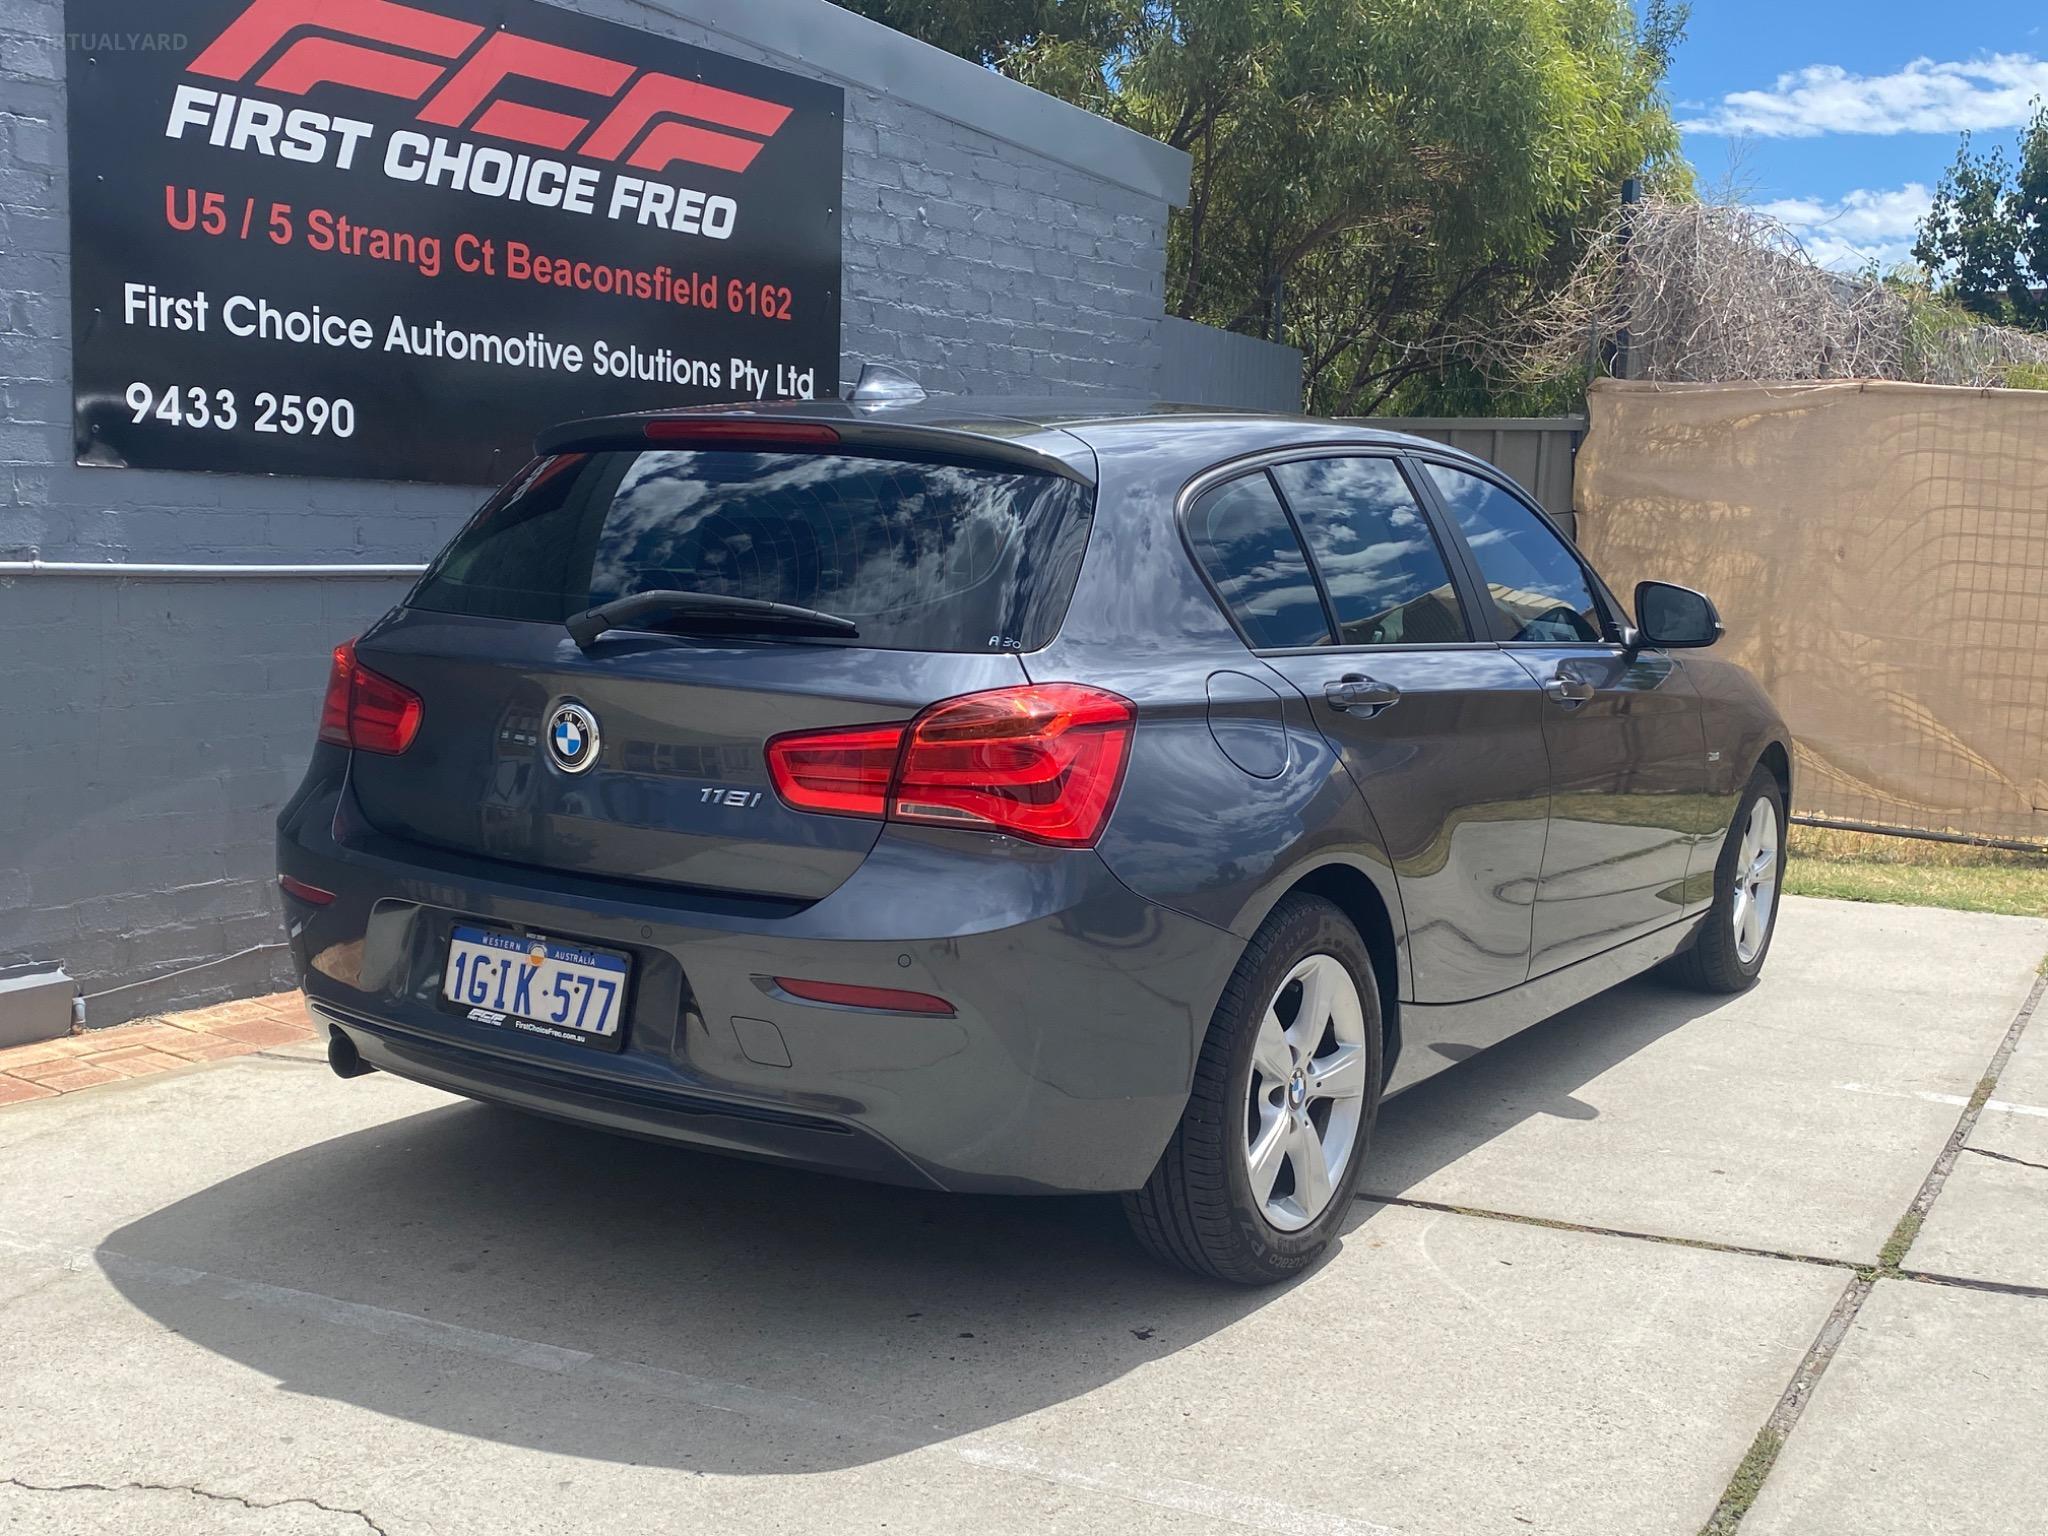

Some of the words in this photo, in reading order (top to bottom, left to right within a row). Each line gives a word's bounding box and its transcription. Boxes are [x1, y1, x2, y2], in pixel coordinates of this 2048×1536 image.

[165, 84, 375, 170] FIRST
[383, 130, 601, 215] CHOICE
[608, 174, 738, 240] FREO
[165, 186, 226, 236] U5
[241, 199, 254, 240] /
[269, 204, 293, 245] 5
[307, 210, 441, 277] Strang
[453, 233, 495, 276] Ct
[506, 241, 719, 310] Beaconsfield
[727, 279, 792, 320] 6162
[124, 282, 209, 333] First
[222, 295, 374, 350] Choice
[383, 315, 584, 374] Automotive
[592, 340, 721, 388] Solutions
[730, 358, 769, 400] Pty
[776, 363, 815, 401] Ltd
[125, 382, 238, 430] 9433
[254, 392, 355, 438] 2590
[482, 935, 522, 951] WESTERN
[555, 951, 596, 967] AUSTRALIA
